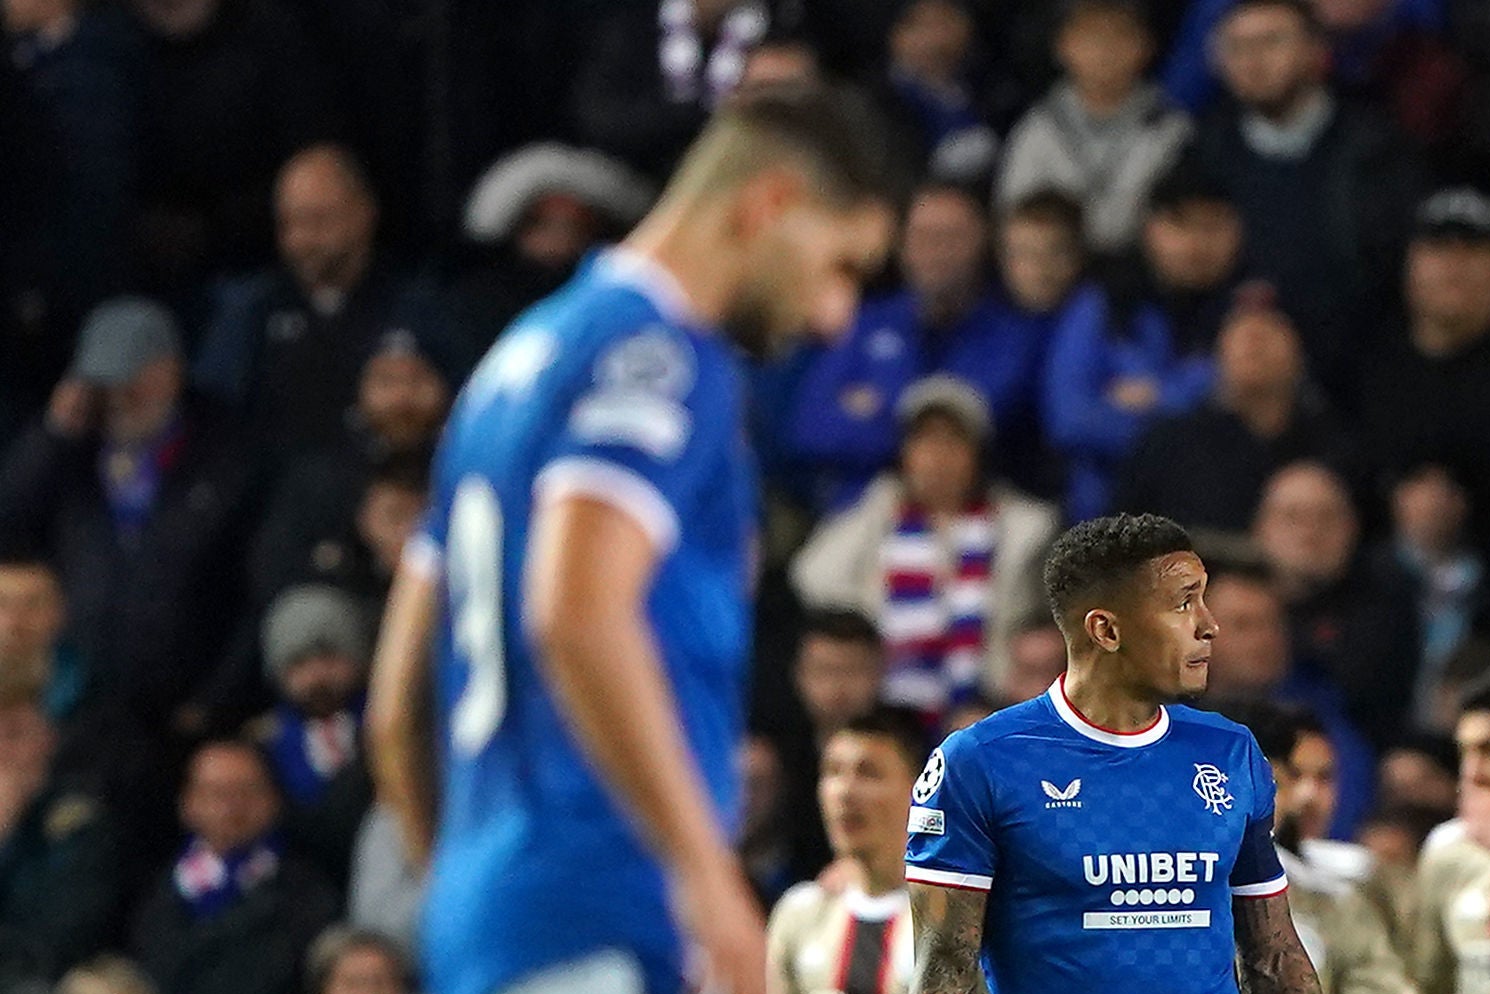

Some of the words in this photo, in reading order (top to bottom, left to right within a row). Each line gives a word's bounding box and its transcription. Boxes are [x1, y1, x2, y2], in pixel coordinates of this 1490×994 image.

[1083, 852, 1220, 886] UNIBET
[1110, 915, 1129, 926] SET
[1131, 915, 1160, 925] YOUR
[1161, 914, 1193, 925] LIMITS
